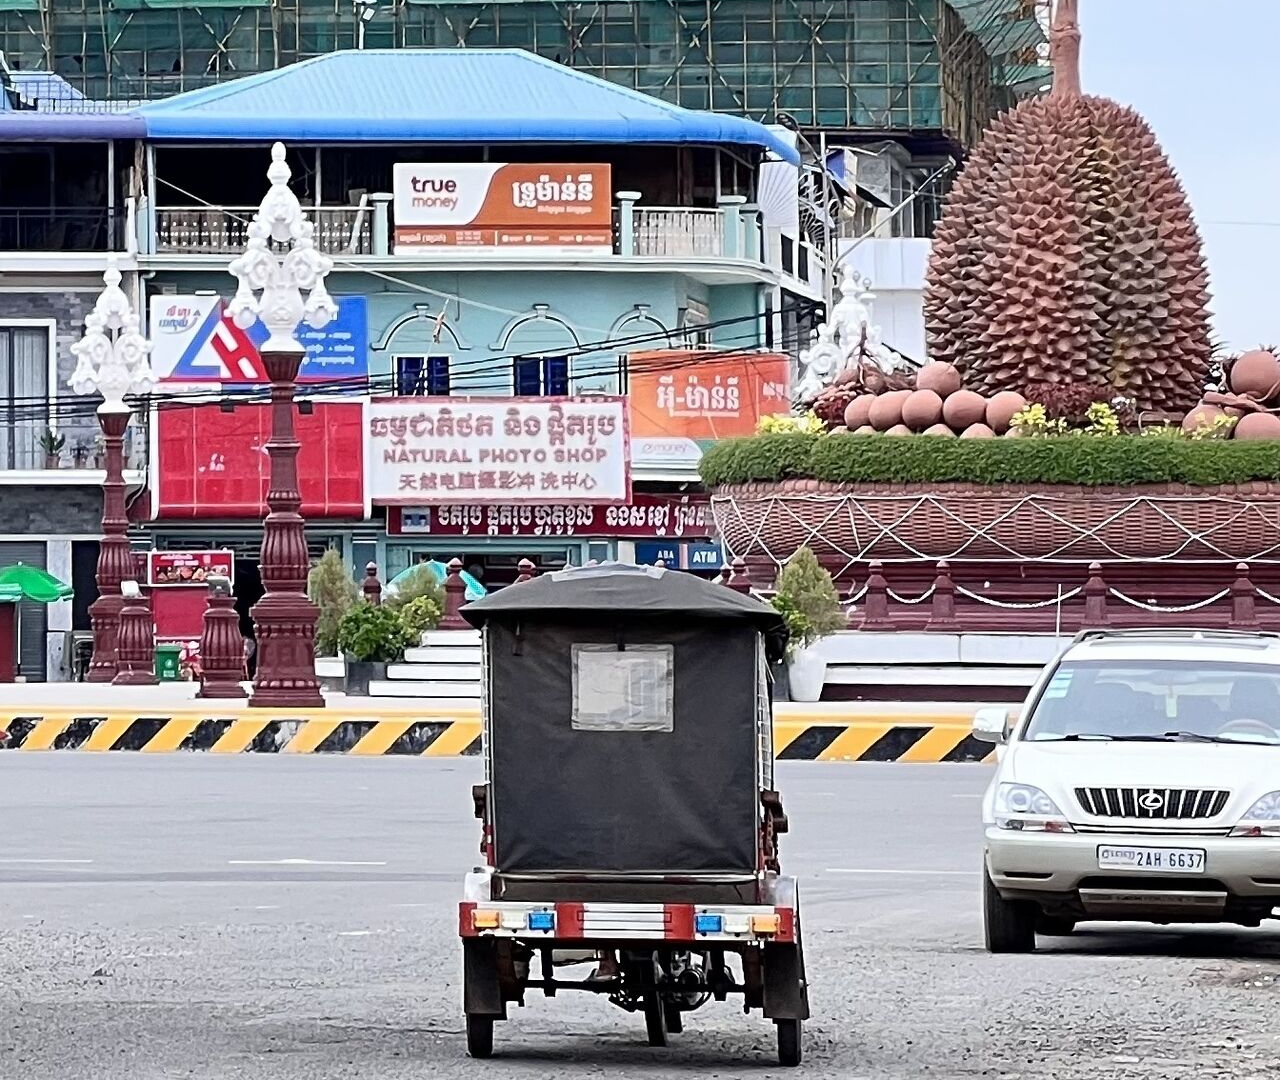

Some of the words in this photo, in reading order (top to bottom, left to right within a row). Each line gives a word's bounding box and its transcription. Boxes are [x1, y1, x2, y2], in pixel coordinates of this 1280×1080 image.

[411, 176, 456, 193] true
[411, 196, 458, 211] money
[383, 449, 472, 463] NATURAL
[479, 449, 546, 463] PHOTO
[554, 449, 608, 463] SHOP
[657, 550, 674, 559] ABA
[693, 551, 717, 563] ATM
